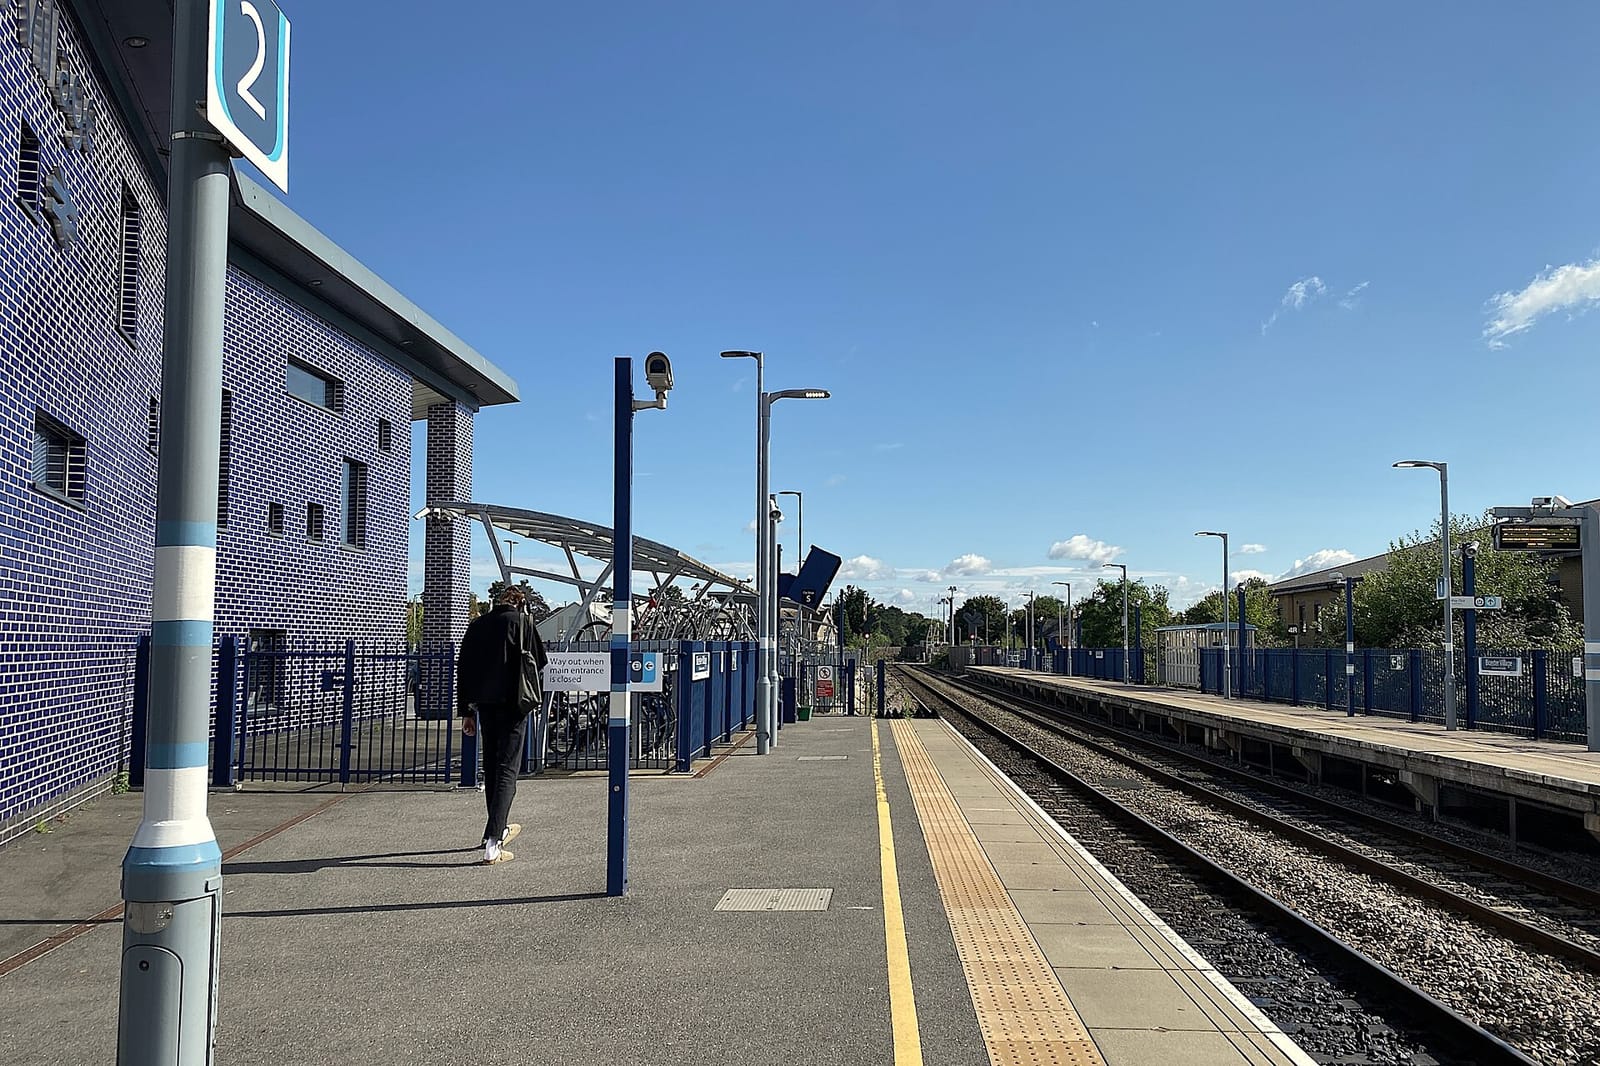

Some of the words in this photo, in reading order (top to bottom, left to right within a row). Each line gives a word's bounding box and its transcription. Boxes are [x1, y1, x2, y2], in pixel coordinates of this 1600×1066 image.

[236, 0, 267, 121] 2
[550, 658, 567, 666] Way
[550, 675, 556, 683] is
[557, 675, 582, 683] closed
